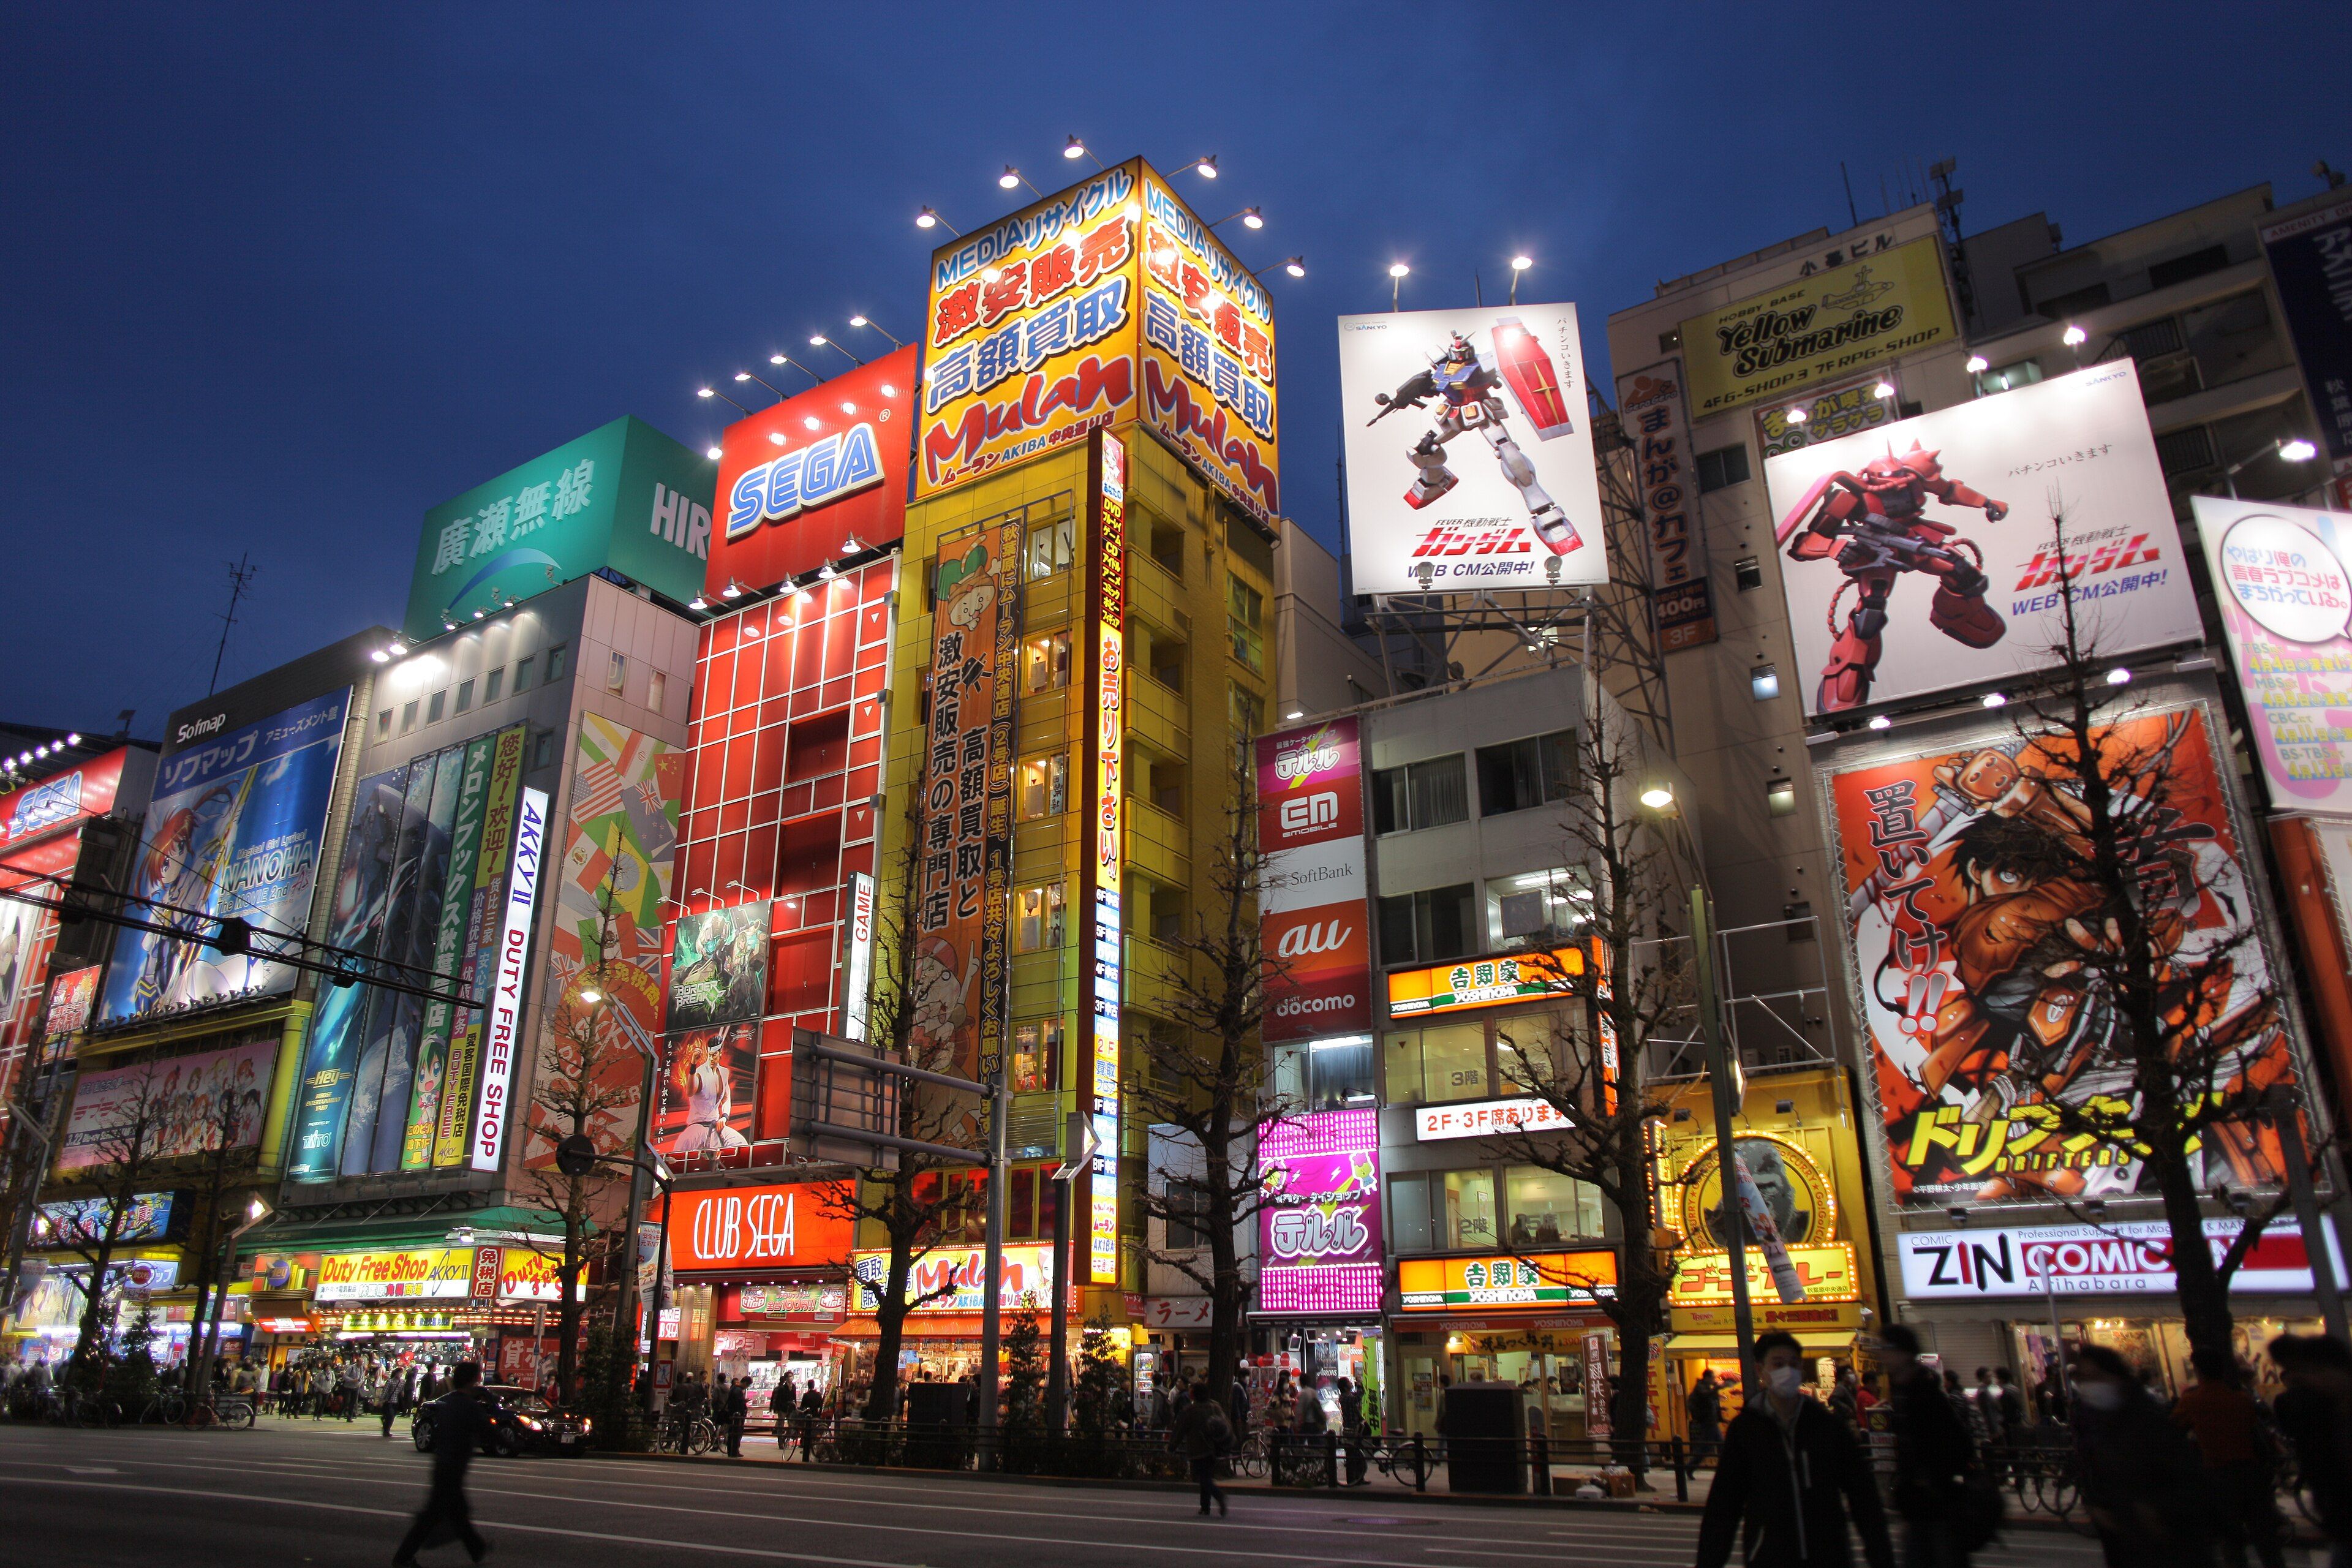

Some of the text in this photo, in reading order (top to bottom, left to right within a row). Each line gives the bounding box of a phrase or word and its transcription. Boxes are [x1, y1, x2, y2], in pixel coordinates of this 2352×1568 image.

[935, 167, 1134, 293] MEDIAリサイクル
[1144, 178, 1272, 325] MEDIAリサイクル
[933, 215, 1129, 347] 激安販売
[1146, 222, 1272, 382] 激安販売
[1719, 289, 1806, 325] HOBBY BASE
[927, 276, 1128, 414] 高額買取
[1717, 304, 1817, 355] Yellow
[1733, 306, 1902, 378] Submarine
[1144, 288, 1273, 439] 高額買取
[1556, 317, 1575, 390] パチンコいきます
[1704, 395, 1722, 410] 4F
[1815, 358, 1836, 375] 7F
[1838, 327, 1941, 367] RPG-SHOP
[924, 355, 1134, 486] Mulan
[1143, 357, 1281, 516] Mulan
[941, 452, 1001, 486] ムーラン
[1001, 435, 1046, 463] AKIBA
[1159, 423, 1202, 463] ムーラン
[1202, 460, 1231, 489] AKIBA
[2008, 443, 2113, 478] パチンコいきます
[726, 423, 884, 538] SEGA
[1640, 407, 1686, 582] まんが@カフェ
[1103, 497, 1121, 518] DVD
[1435, 517, 1513, 528] FEVER 機動戦士
[1103, 524, 1121, 547] ゲーム
[1105, 541, 1118, 557] CD
[1411, 526, 1531, 557] ガンダム
[1102, 567, 1121, 586] アニメ
[1453, 560, 1536, 577] CM公開中!
[2014, 532, 2162, 593] ガンダム
[2011, 594, 2060, 616] WEB
[1669, 625, 1696, 645] 3F
[176, 712, 227, 744] Sofmap
[263, 704, 339, 745] アミューズメント館
[164, 729, 258, 788] ソフマップ
[1275, 742, 1341, 781] テルル
[921, 630, 963, 933] 激安販売の専門店
[8, 771, 83, 840] SEGA
[953, 726, 989, 920] 高額買取と
[1282, 823, 1338, 839] EMOBILE
[518, 800, 545, 885] AKKY
[218, 840, 314, 899] NANOHA
[1290, 863, 1353, 886] SoftBank
[217, 900, 233, 915] The
[235, 888, 270, 910] MOVIE
[268, 882, 290, 901] 2nd
[1096, 888, 1106, 901] 6F
[1863, 779, 1951, 1035] 置いてけ!!
[856, 881, 872, 943] GAME
[1096, 924, 1106, 938] 5F
[1278, 919, 1352, 958] au
[501, 929, 525, 1000] DUTY
[1095, 962, 1105, 974] 4F
[1448, 959, 1520, 992] 吉野家
[673, 980, 726, 997] BORDER
[1453, 986, 1518, 1003] YOSHINOYA
[1095, 999, 1105, 1012] 3F
[1276, 993, 1356, 1018] docomo
[1392, 1000, 1431, 1012] YOSHINOYA
[491, 1008, 514, 1077] FREE
[1096, 1060, 1115, 1078] 買取
[1450, 1069, 1479, 1087] 3階
[479, 1082, 503, 1158] SHOP
[1094, 1098, 1104, 1112] 1F
[303, 1129, 332, 1149] TAITO
[1093, 1156, 1104, 1171] B1F
[1996, 1150, 2130, 1174] DRIFTERS
[693, 1193, 795, 1260] CLUB SEGA
[1093, 1218, 1115, 1232] ムーラン
[1272, 1206, 1366, 1256] テルル
[1911, 1234, 1954, 1248] COMIC
[2018, 1228, 2079, 1240] Professional
[2127, 1225, 2143, 1235] for
[1093, 1238, 1115, 1252] AKIBA
[2026, 1240, 2170, 1275] COMIC
[323, 1253, 428, 1283] Duty Free Shop
[427, 1250, 460, 1297] AKKY
[475, 1247, 498, 1297] 免税店
[856, 1256, 884, 1281] 買取
[1465, 1260, 1540, 1289] 吉野家
[1912, 1232, 2015, 1292] ZIN
[1124, 1294, 1142, 1302] ラーメン
[1403, 1294, 1445, 1305] YOSHINOYA
[1469, 1289, 1538, 1303] YOSHINOYA
[2029, 1276, 2147, 1292] Aihabara
[1156, 1301, 1210, 1324] ラーメ
[1533, 1317, 1585, 1329] YOSHINOYA
